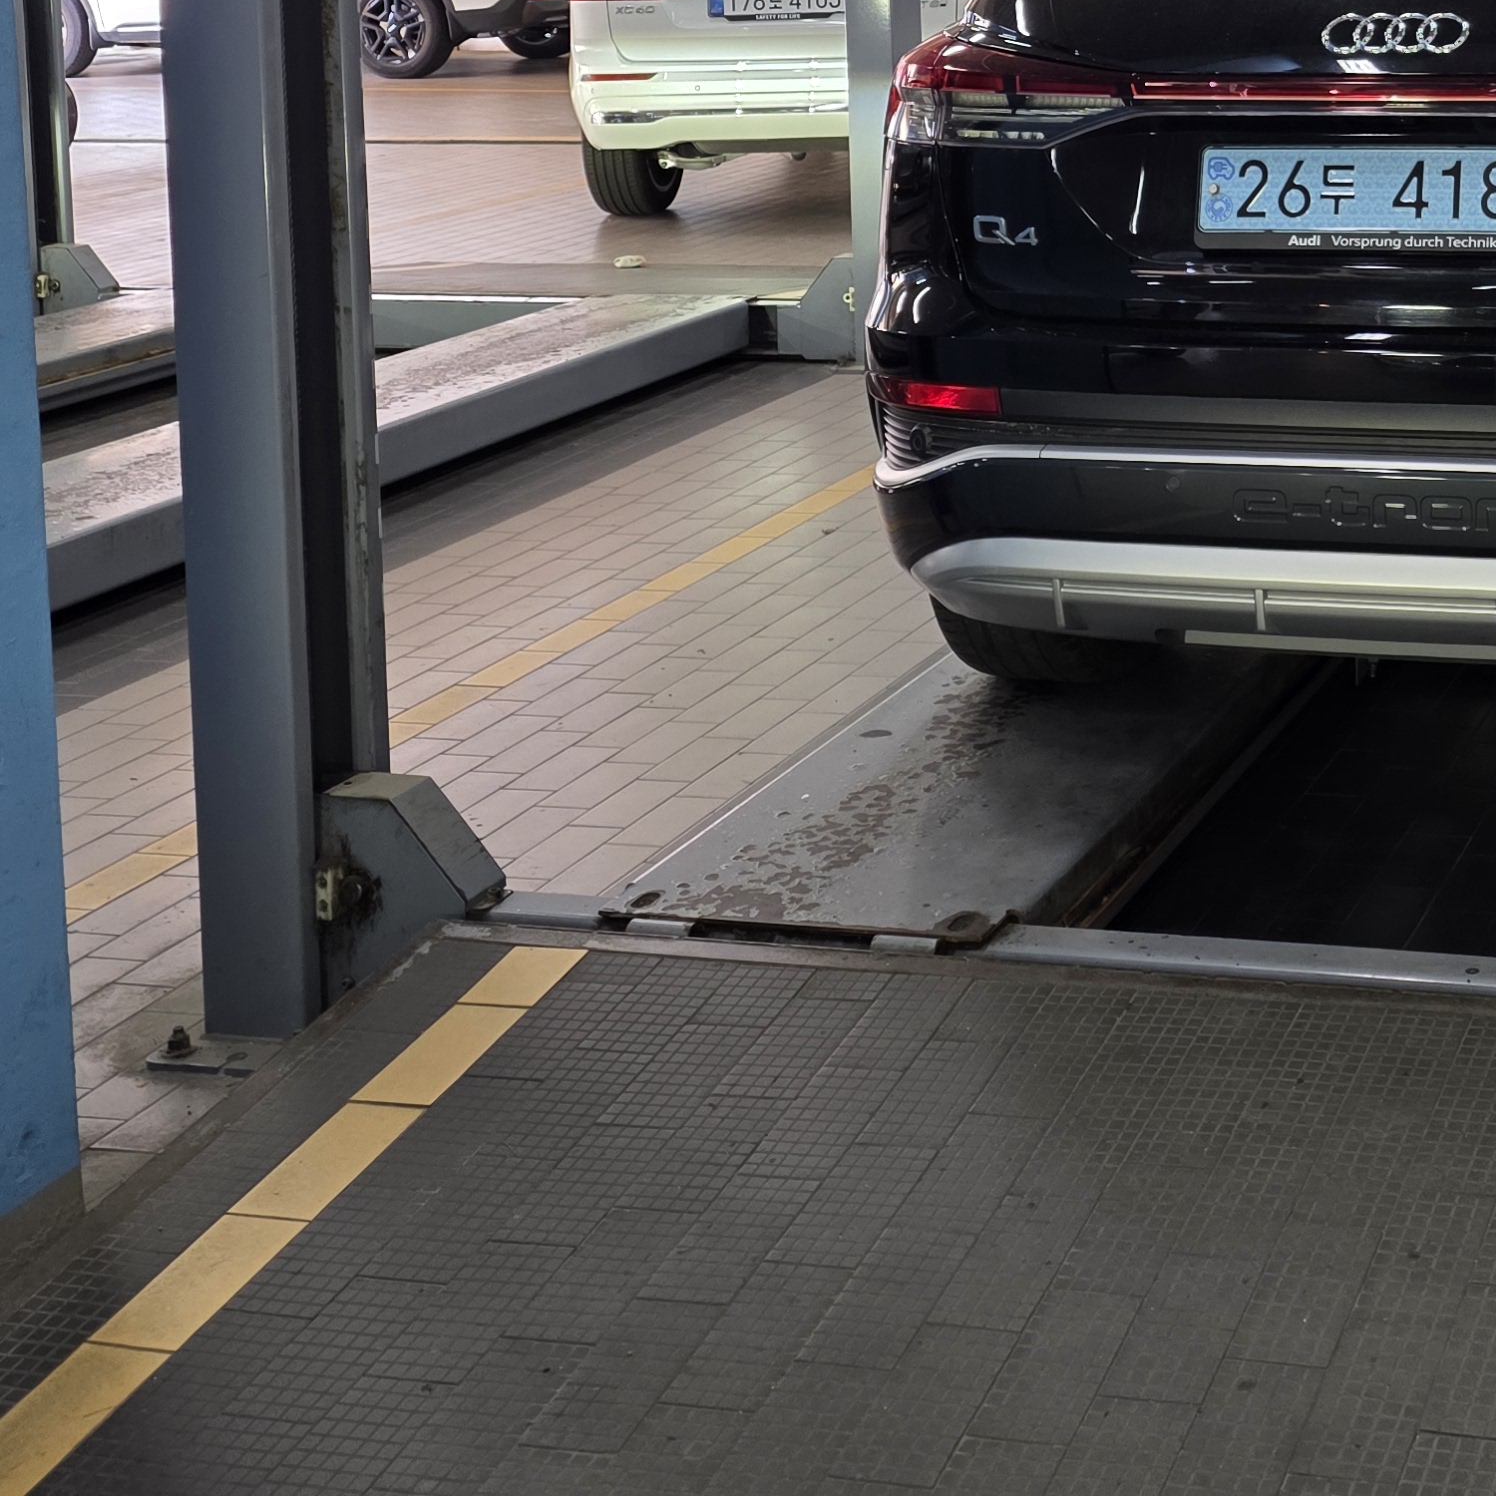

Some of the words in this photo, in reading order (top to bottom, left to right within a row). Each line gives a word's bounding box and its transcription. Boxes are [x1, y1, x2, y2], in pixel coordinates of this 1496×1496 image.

[1236, 159, 1356, 218] 26두
[973, 214, 1039, 246] Q4
[1288, 234, 1321, 247] Audi
[1331, 235, 1402, 250] Vorsprung
[1404, 236, 1444, 248] durch
